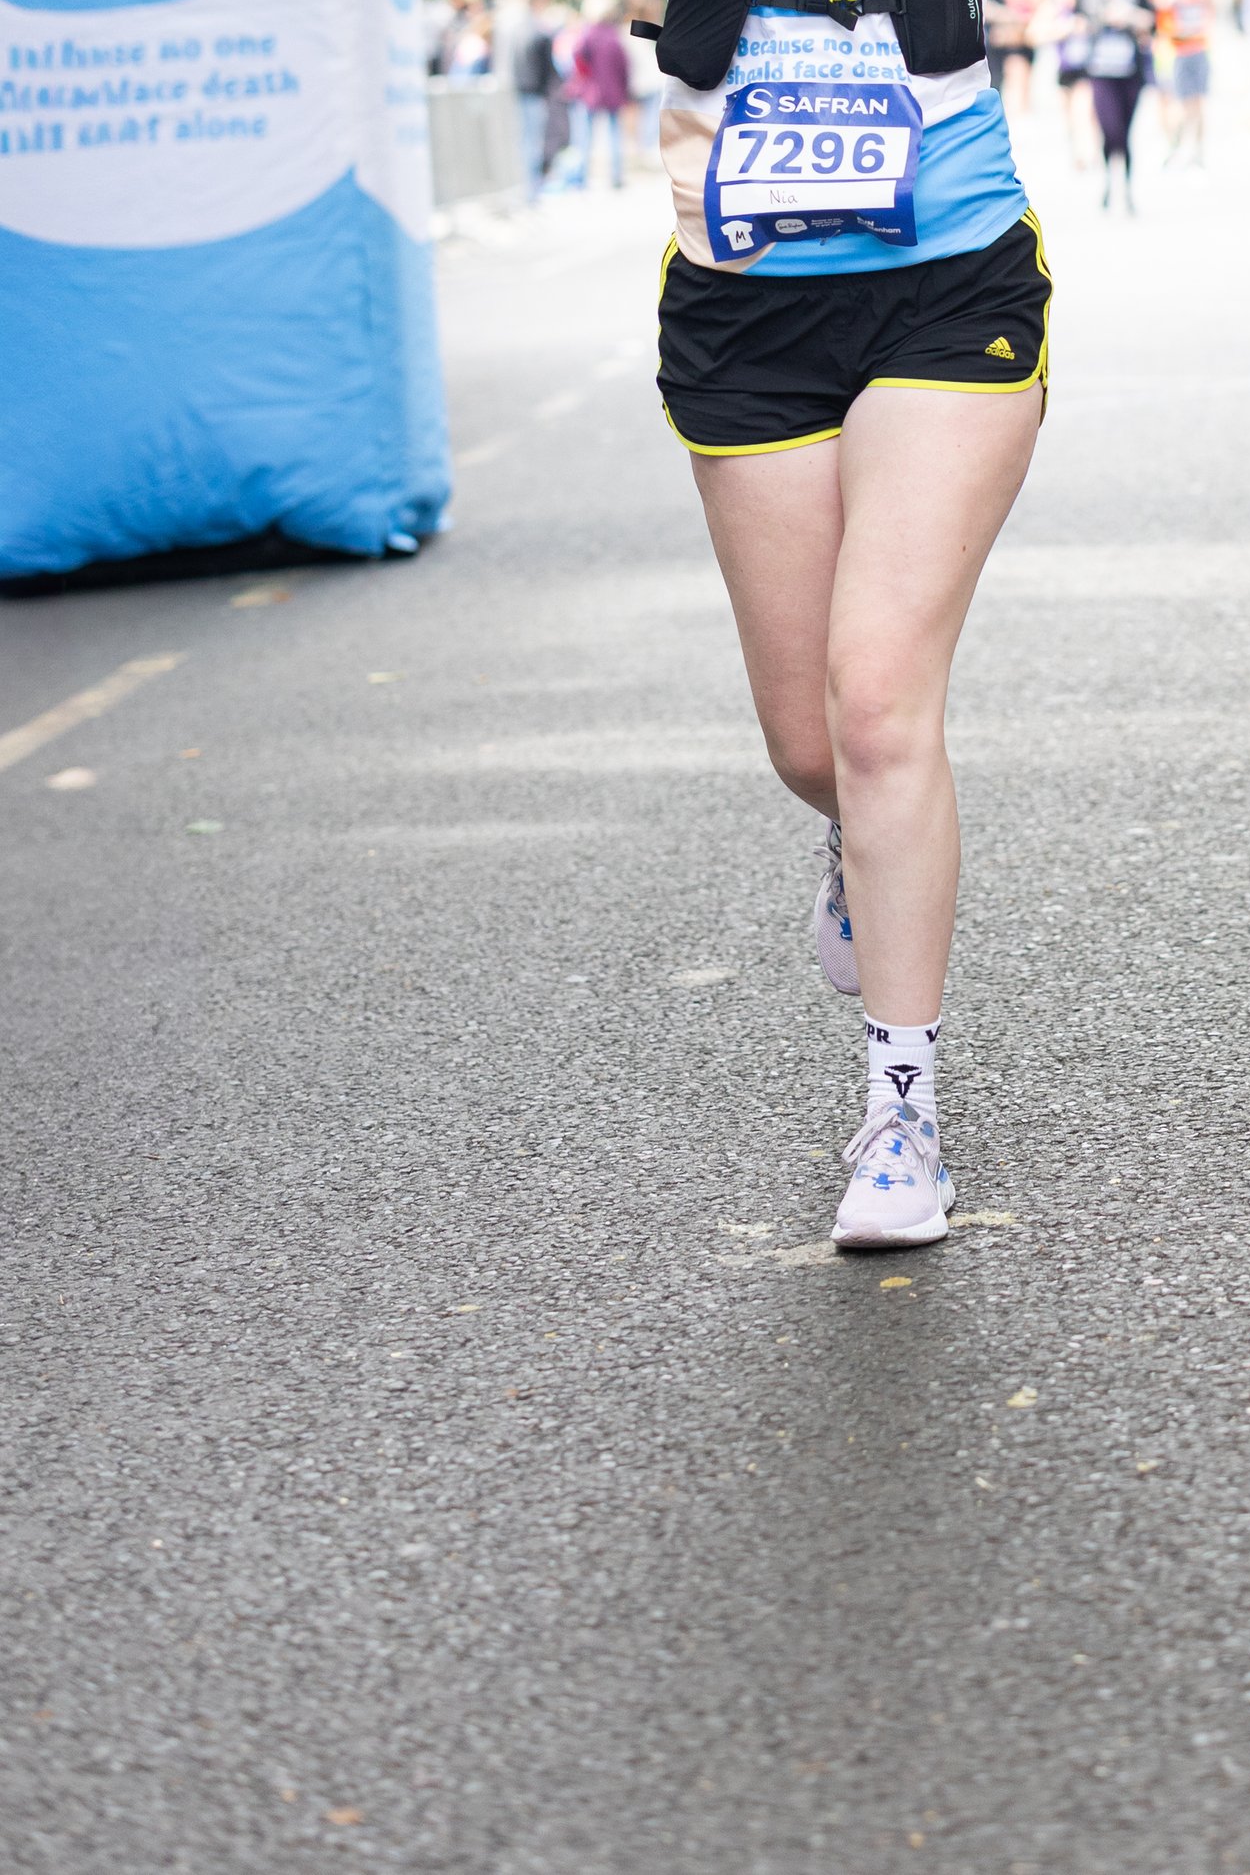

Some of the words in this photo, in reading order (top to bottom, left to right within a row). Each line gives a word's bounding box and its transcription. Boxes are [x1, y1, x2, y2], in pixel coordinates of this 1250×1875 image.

[160, 36, 202, 62] no
[213, 33, 276, 59] one
[737, 36, 815, 57] Because
[823, 38, 853, 55] no
[860, 39, 902, 57] one
[792, 62, 844, 79] face
[852, 61, 912, 82] deat
[202, 68, 299, 99] death
[778, 95, 889, 115] SAFRAN
[175, 109, 267, 141] alone
[738, 130, 886, 174] 7296
[769, 189, 799, 205] Nia
[735, 230, 746, 243] M
[985, 347, 1015, 360] adidas
[865, 1021, 892, 1044] PR
